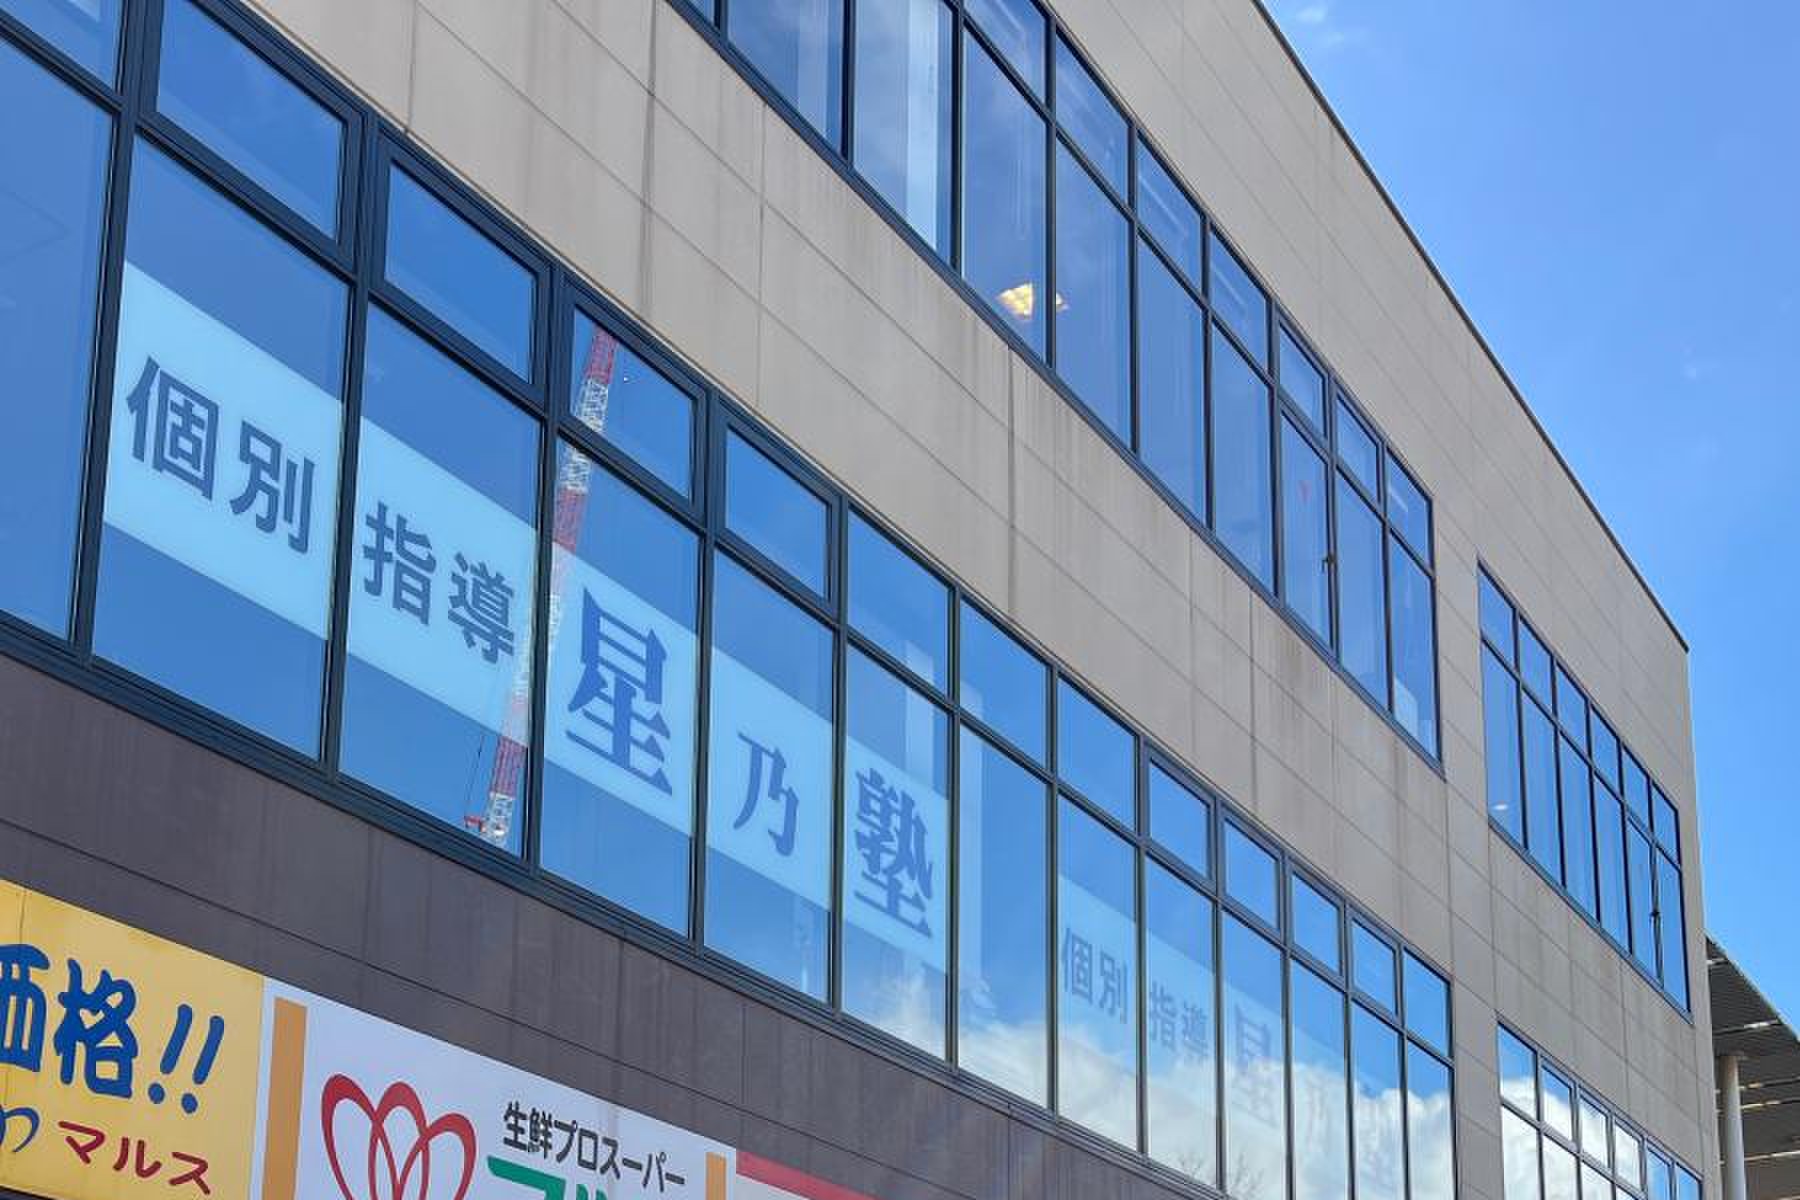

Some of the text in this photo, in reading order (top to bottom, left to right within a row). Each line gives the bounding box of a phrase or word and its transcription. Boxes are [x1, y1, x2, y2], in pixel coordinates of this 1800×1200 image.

[126, 354, 934, 938] 個別指導 星乃塾
[57, 1120, 211, 1195] マルス
[503, 1100, 686, 1193] 生鮮プロスーパー
